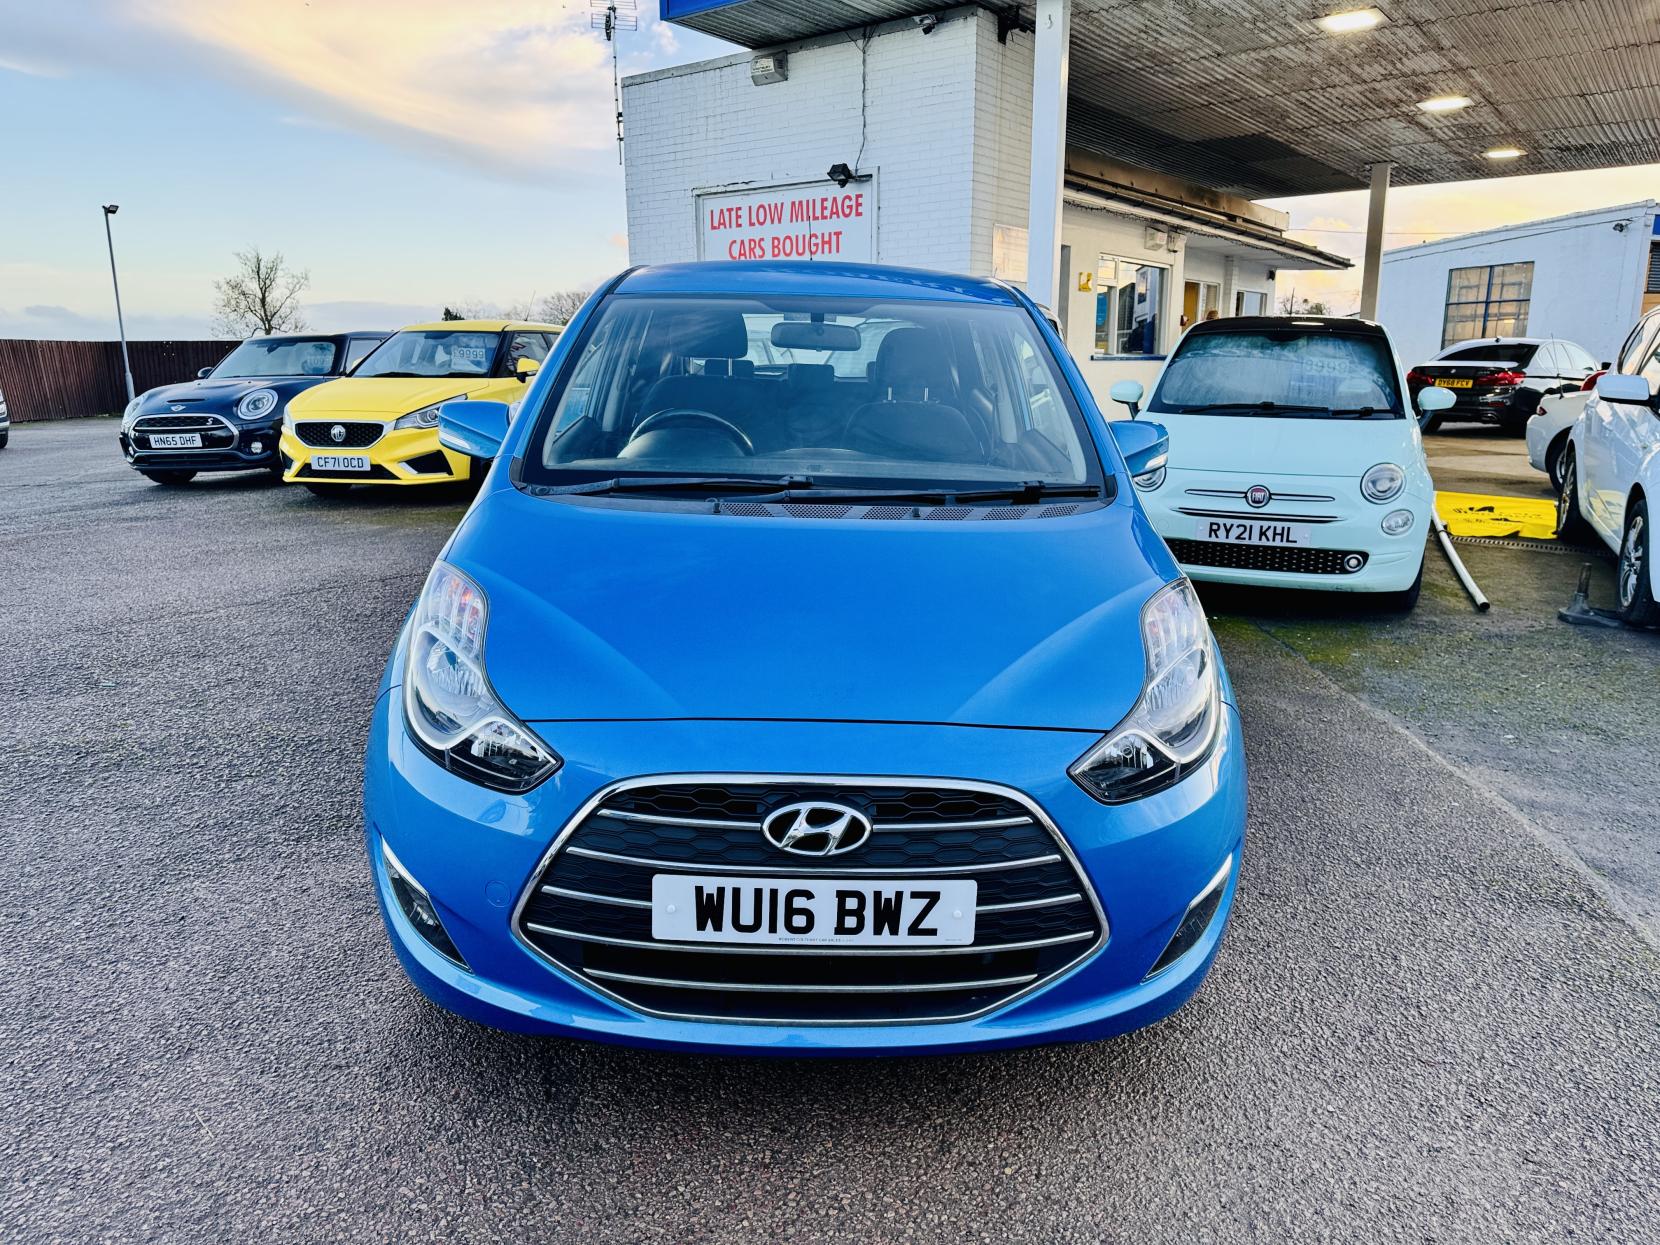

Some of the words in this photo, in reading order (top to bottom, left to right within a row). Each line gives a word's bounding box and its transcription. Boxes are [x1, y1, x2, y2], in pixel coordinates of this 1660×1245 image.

[710, 206, 742, 231] LATE
[748, 202, 785, 227] LOW
[789, 194, 863, 223] MILEAGE
[728, 237, 766, 260] CARS
[771, 230, 843, 258] BOUGHT
[153, 436, 178, 447] HN65
[180, 435, 197, 446] DHF
[317, 456, 341, 468] CF71
[343, 457, 364, 468] OCD
[1208, 521, 1254, 541] RY21
[1258, 524, 1298, 544] KHL
[694, 885, 816, 935] WU16
[833, 889, 942, 937] BWZ
